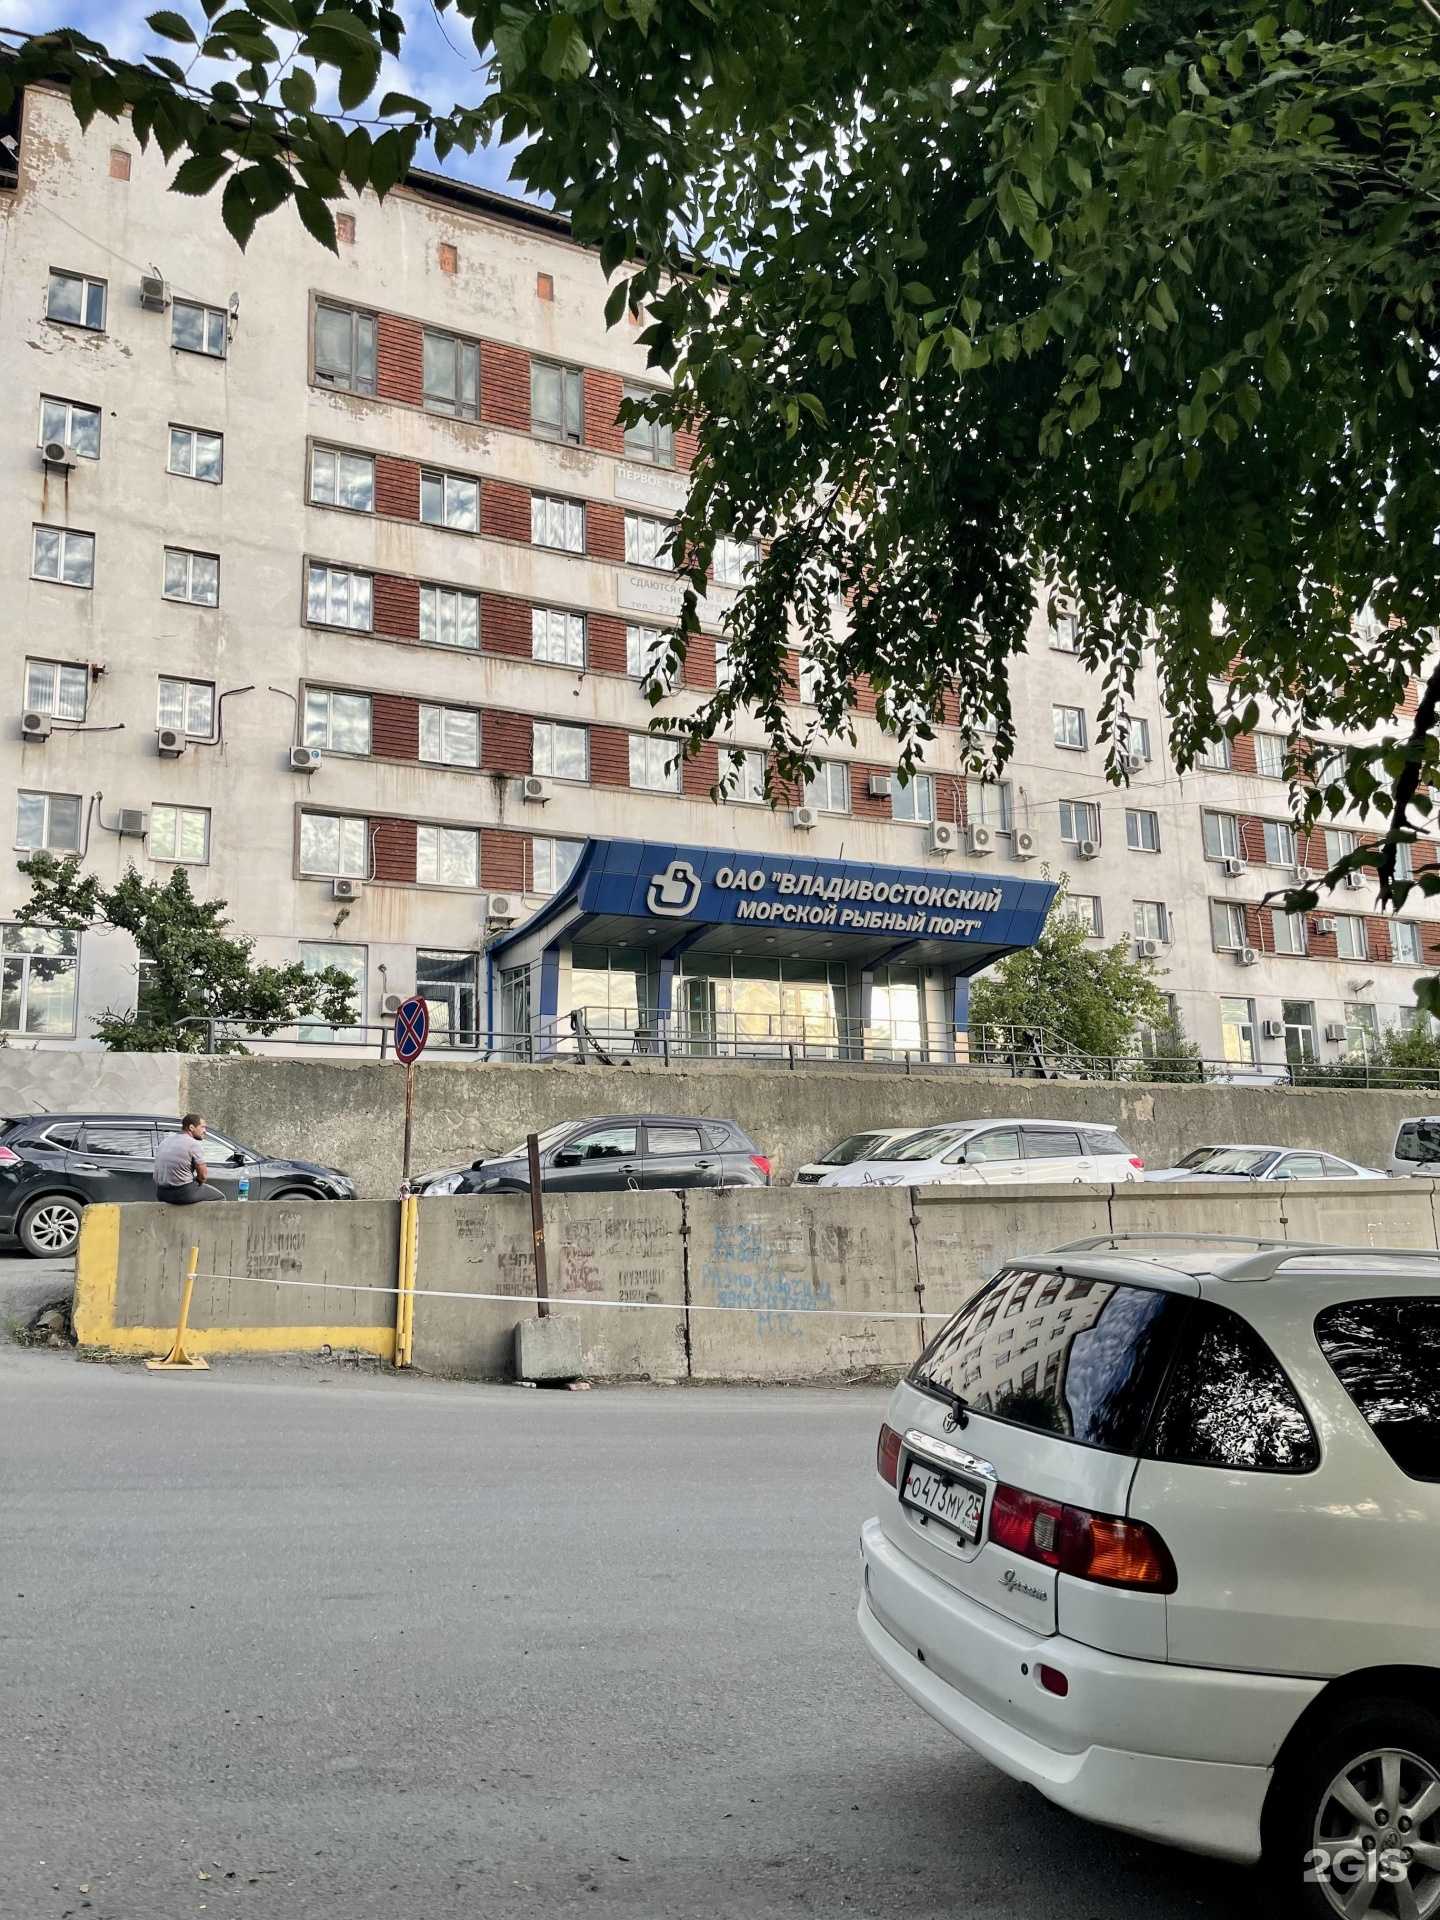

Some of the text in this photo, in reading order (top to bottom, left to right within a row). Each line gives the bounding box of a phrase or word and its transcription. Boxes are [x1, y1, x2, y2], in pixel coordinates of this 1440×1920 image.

[715, 867, 1003, 912] ОАО "ВЛАДИВОСТОКСКИЙ
[737, 900, 982, 937] МОРСКОЙ РЫБНЫЙ ПОРТ"
